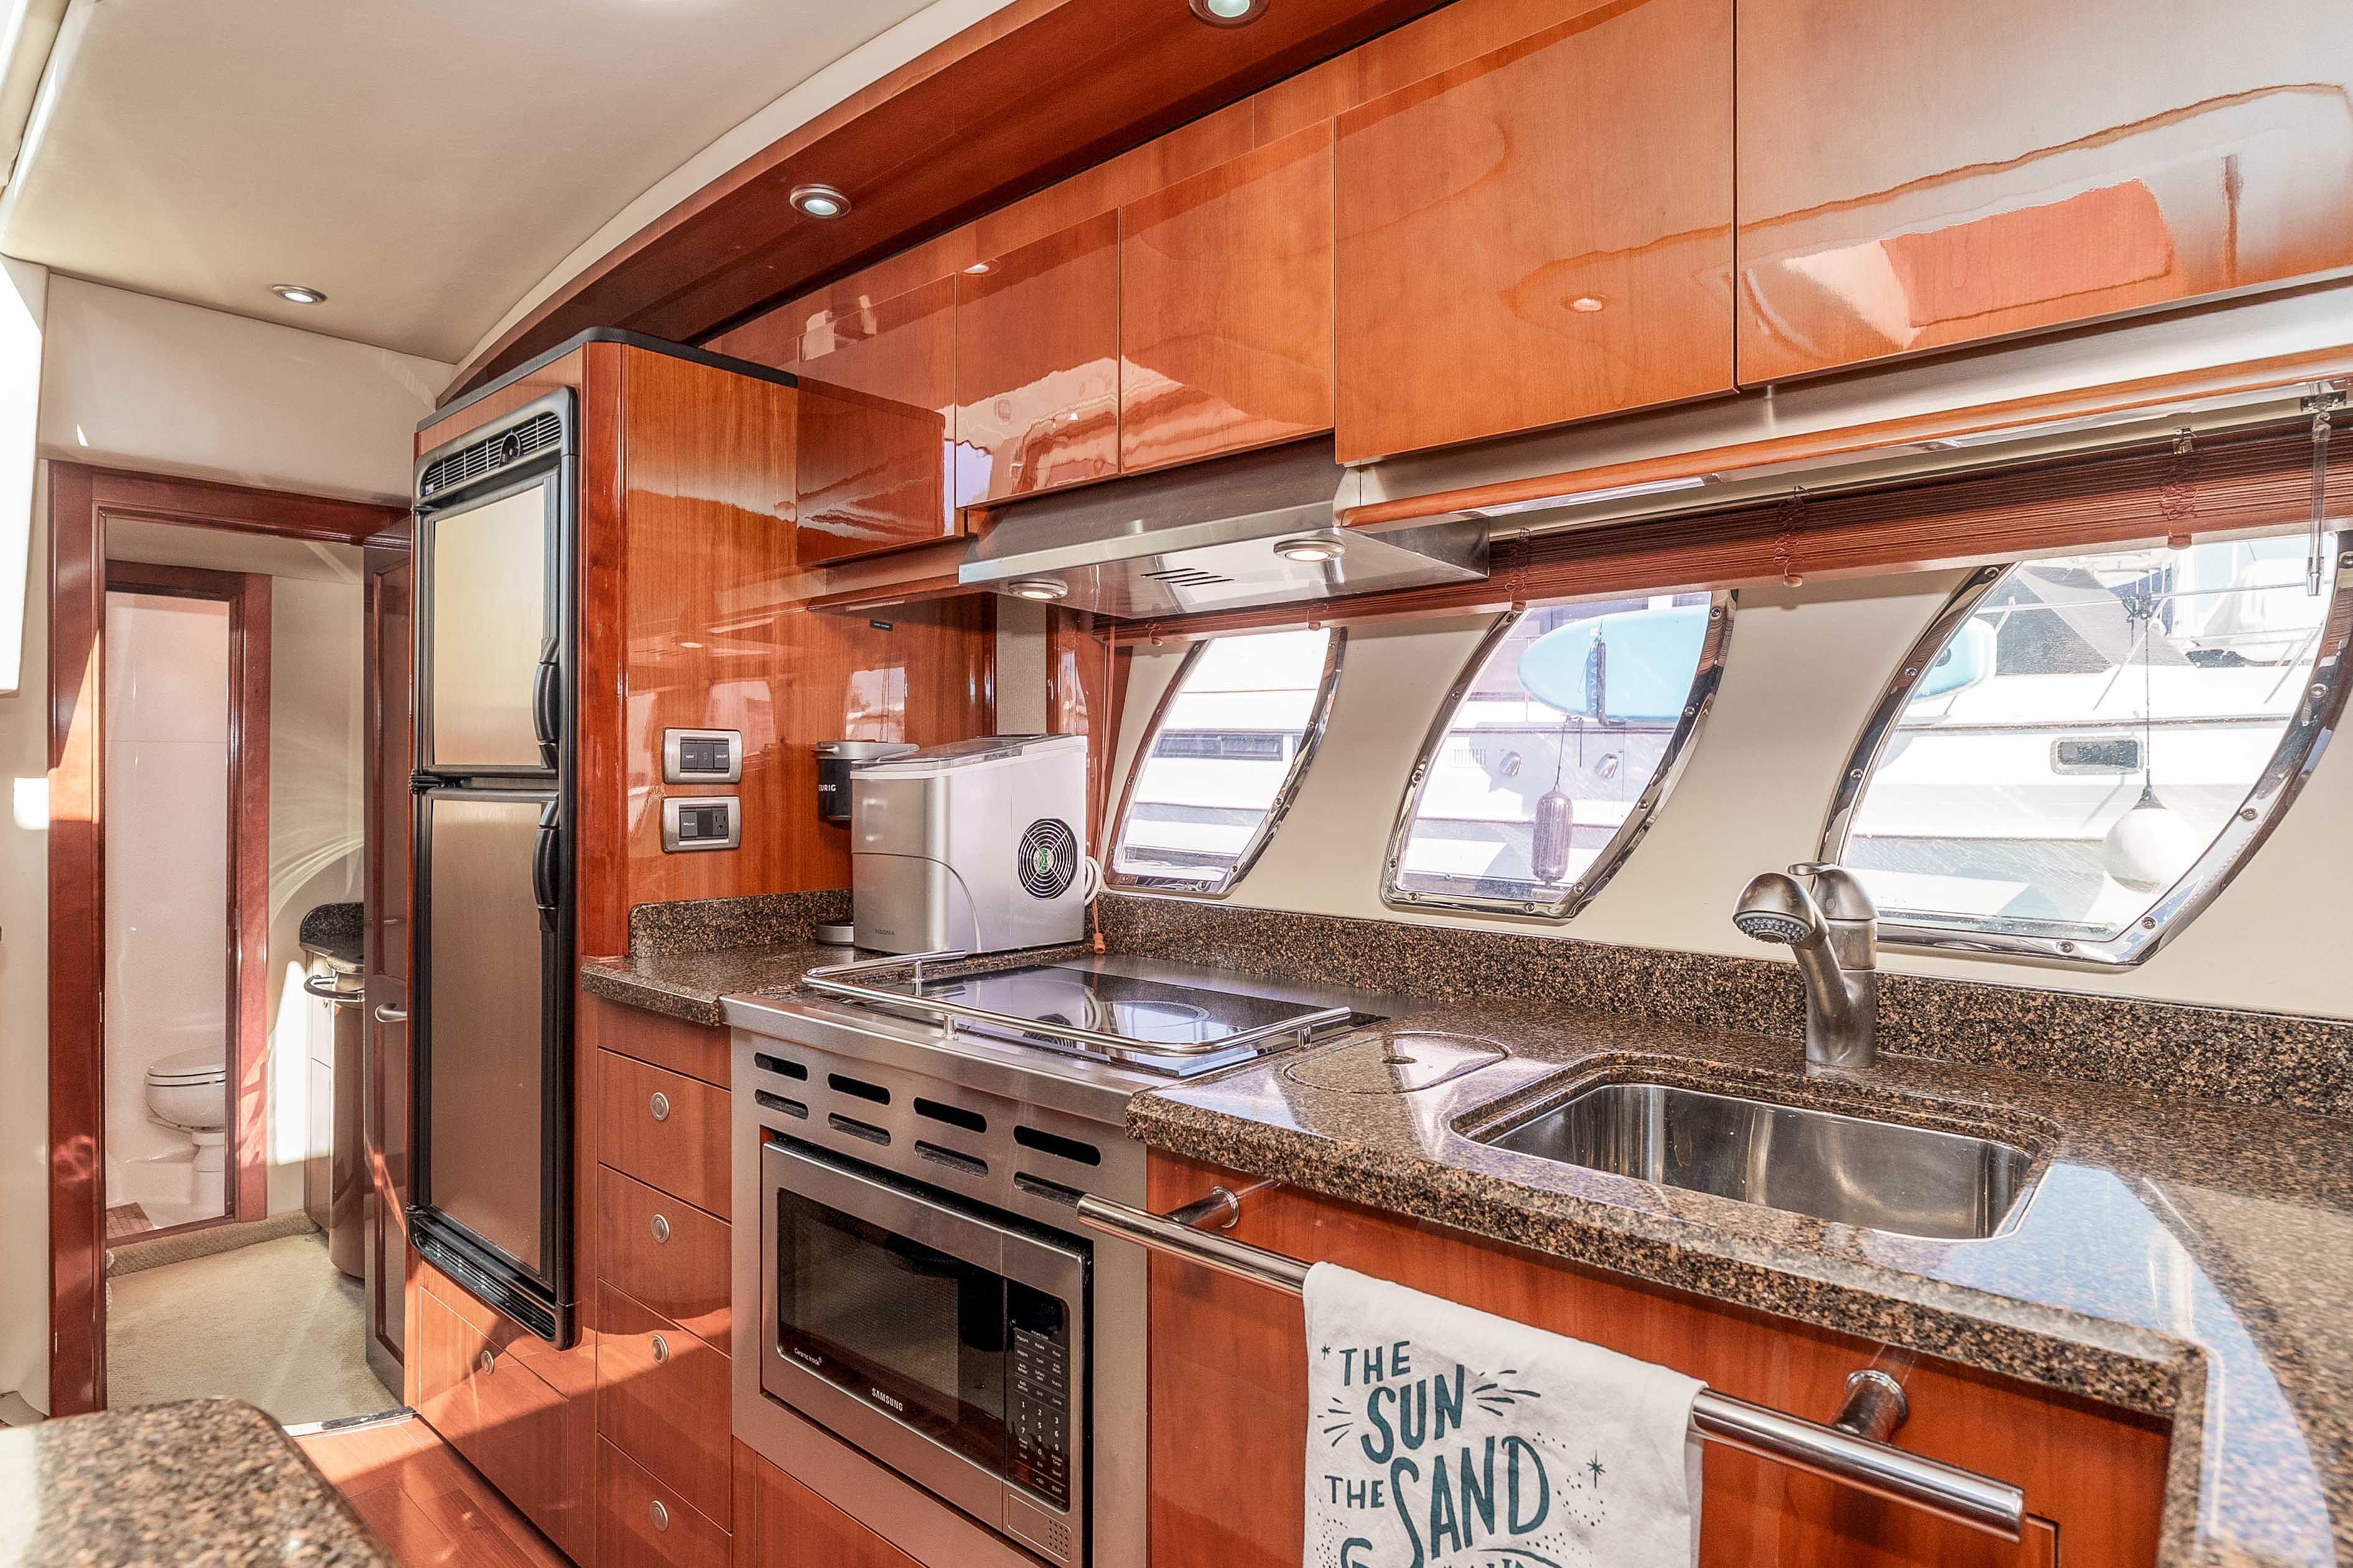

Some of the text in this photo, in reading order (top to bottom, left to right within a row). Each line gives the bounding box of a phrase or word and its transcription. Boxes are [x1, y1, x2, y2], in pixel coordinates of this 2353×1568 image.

[817, 784, 837, 792] EURIG
[1339, 1340, 1411, 1386] THE
[872, 1388, 903, 1411] SAMSUNG
[1361, 1364, 1465, 1464] SUN
[1325, 1436, 1549, 1568] THE SAND
